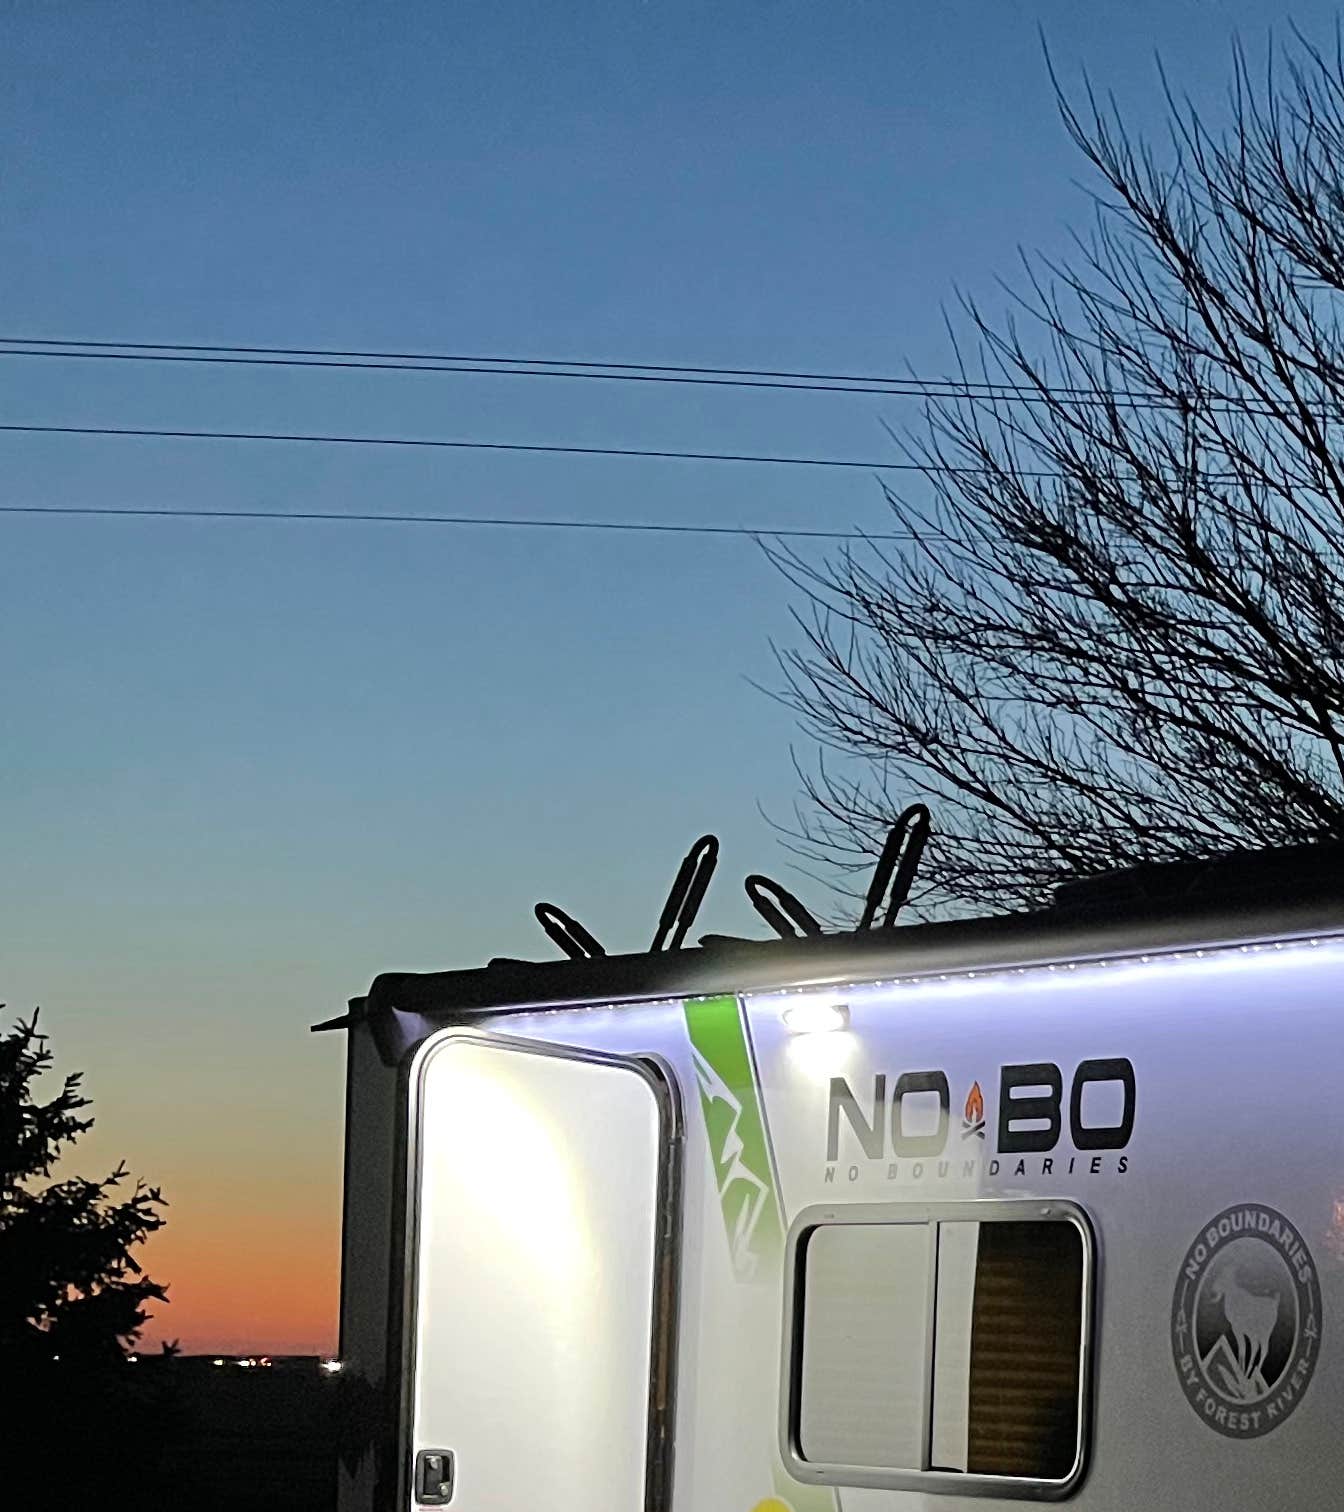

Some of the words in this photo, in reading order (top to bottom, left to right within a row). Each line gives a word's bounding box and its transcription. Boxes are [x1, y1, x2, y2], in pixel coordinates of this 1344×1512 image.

[826, 1070, 950, 1161] NO
[997, 1057, 1136, 1153] BO
[824, 1165, 859, 1183] NO
[887, 1156, 1129, 1180] BOUNDARIES
[1185, 1245, 1207, 1280] NO
[1206, 1210, 1312, 1283] BOUNDARIES
[1179, 1354, 1199, 1386] BY
[1196, 1390, 1260, 1430] FOREST
[1267, 1359, 1309, 1419] RIVER
